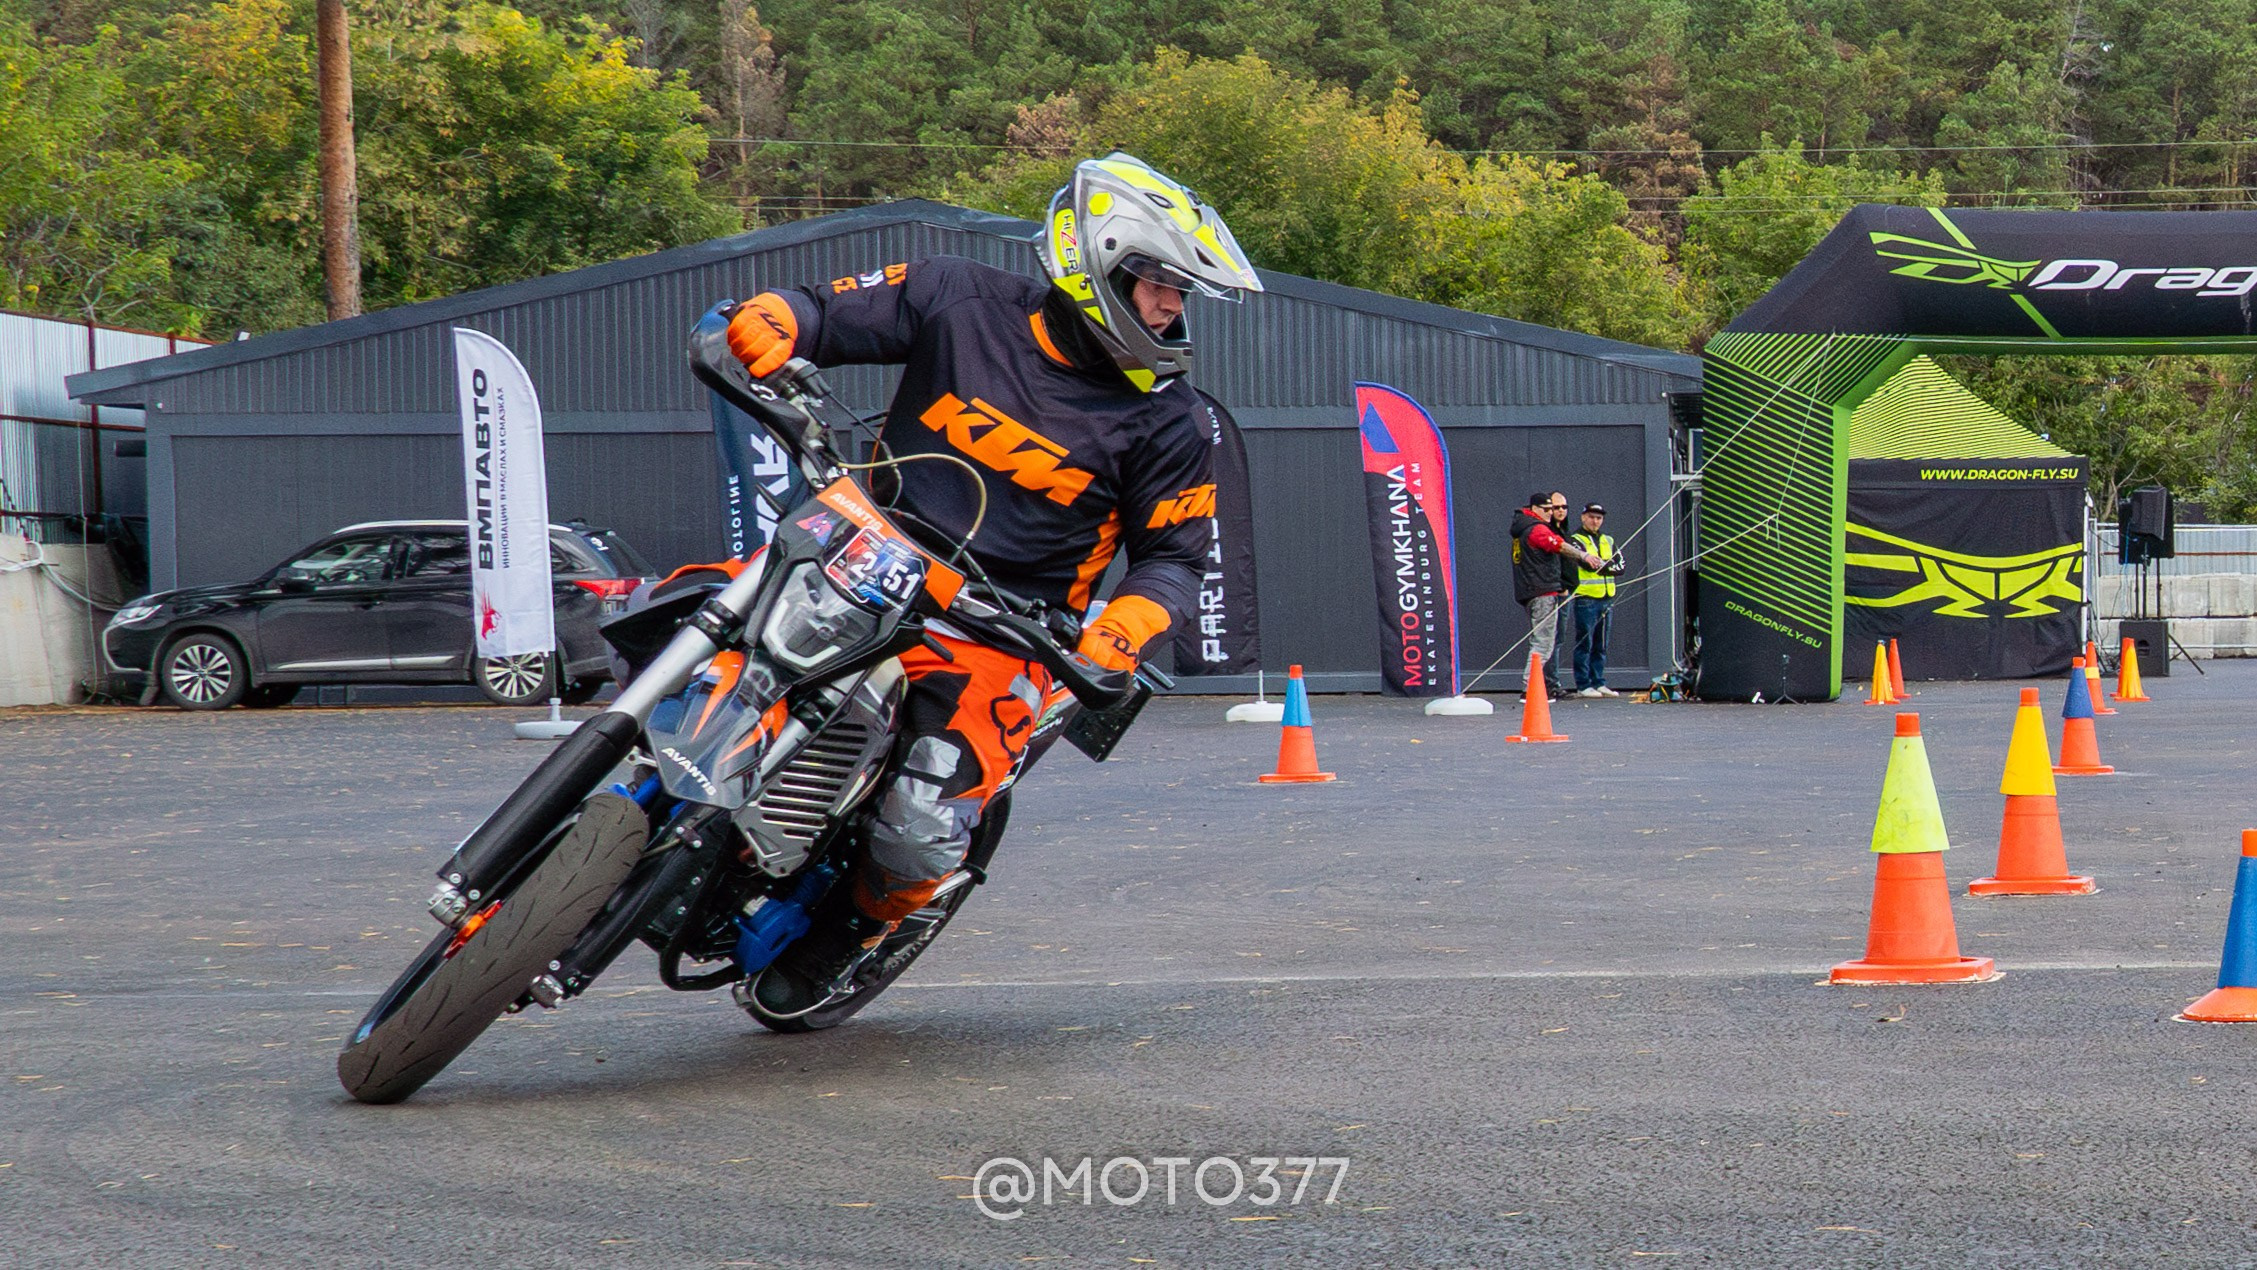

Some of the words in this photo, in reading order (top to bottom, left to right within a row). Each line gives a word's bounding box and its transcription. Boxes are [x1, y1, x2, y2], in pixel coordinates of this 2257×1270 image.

[1061, 214, 1080, 272] HIZER
[2028, 259, 2257, 297] Drag
[473, 368, 494, 569] ВМПАВТО
[499, 447, 507, 492] МАСЛАХ
[919, 392, 1095, 507] KTM
[1411, 462, 1425, 514] TEAM
[1920, 468, 2079, 481] WWW.DRAGON-FLY.SU
[830, 492, 884, 532] AVANTIS
[1146, 484, 1217, 530] KTM
[882, 562, 922, 600] 51
[1386, 464, 1424, 688] MOTOGYMKHANA
[1417, 529, 1438, 686] EKATERINBURG
[1724, 600, 1823, 649] DRAGONFLY.SU
[661, 747, 717, 796] AVANTIS
